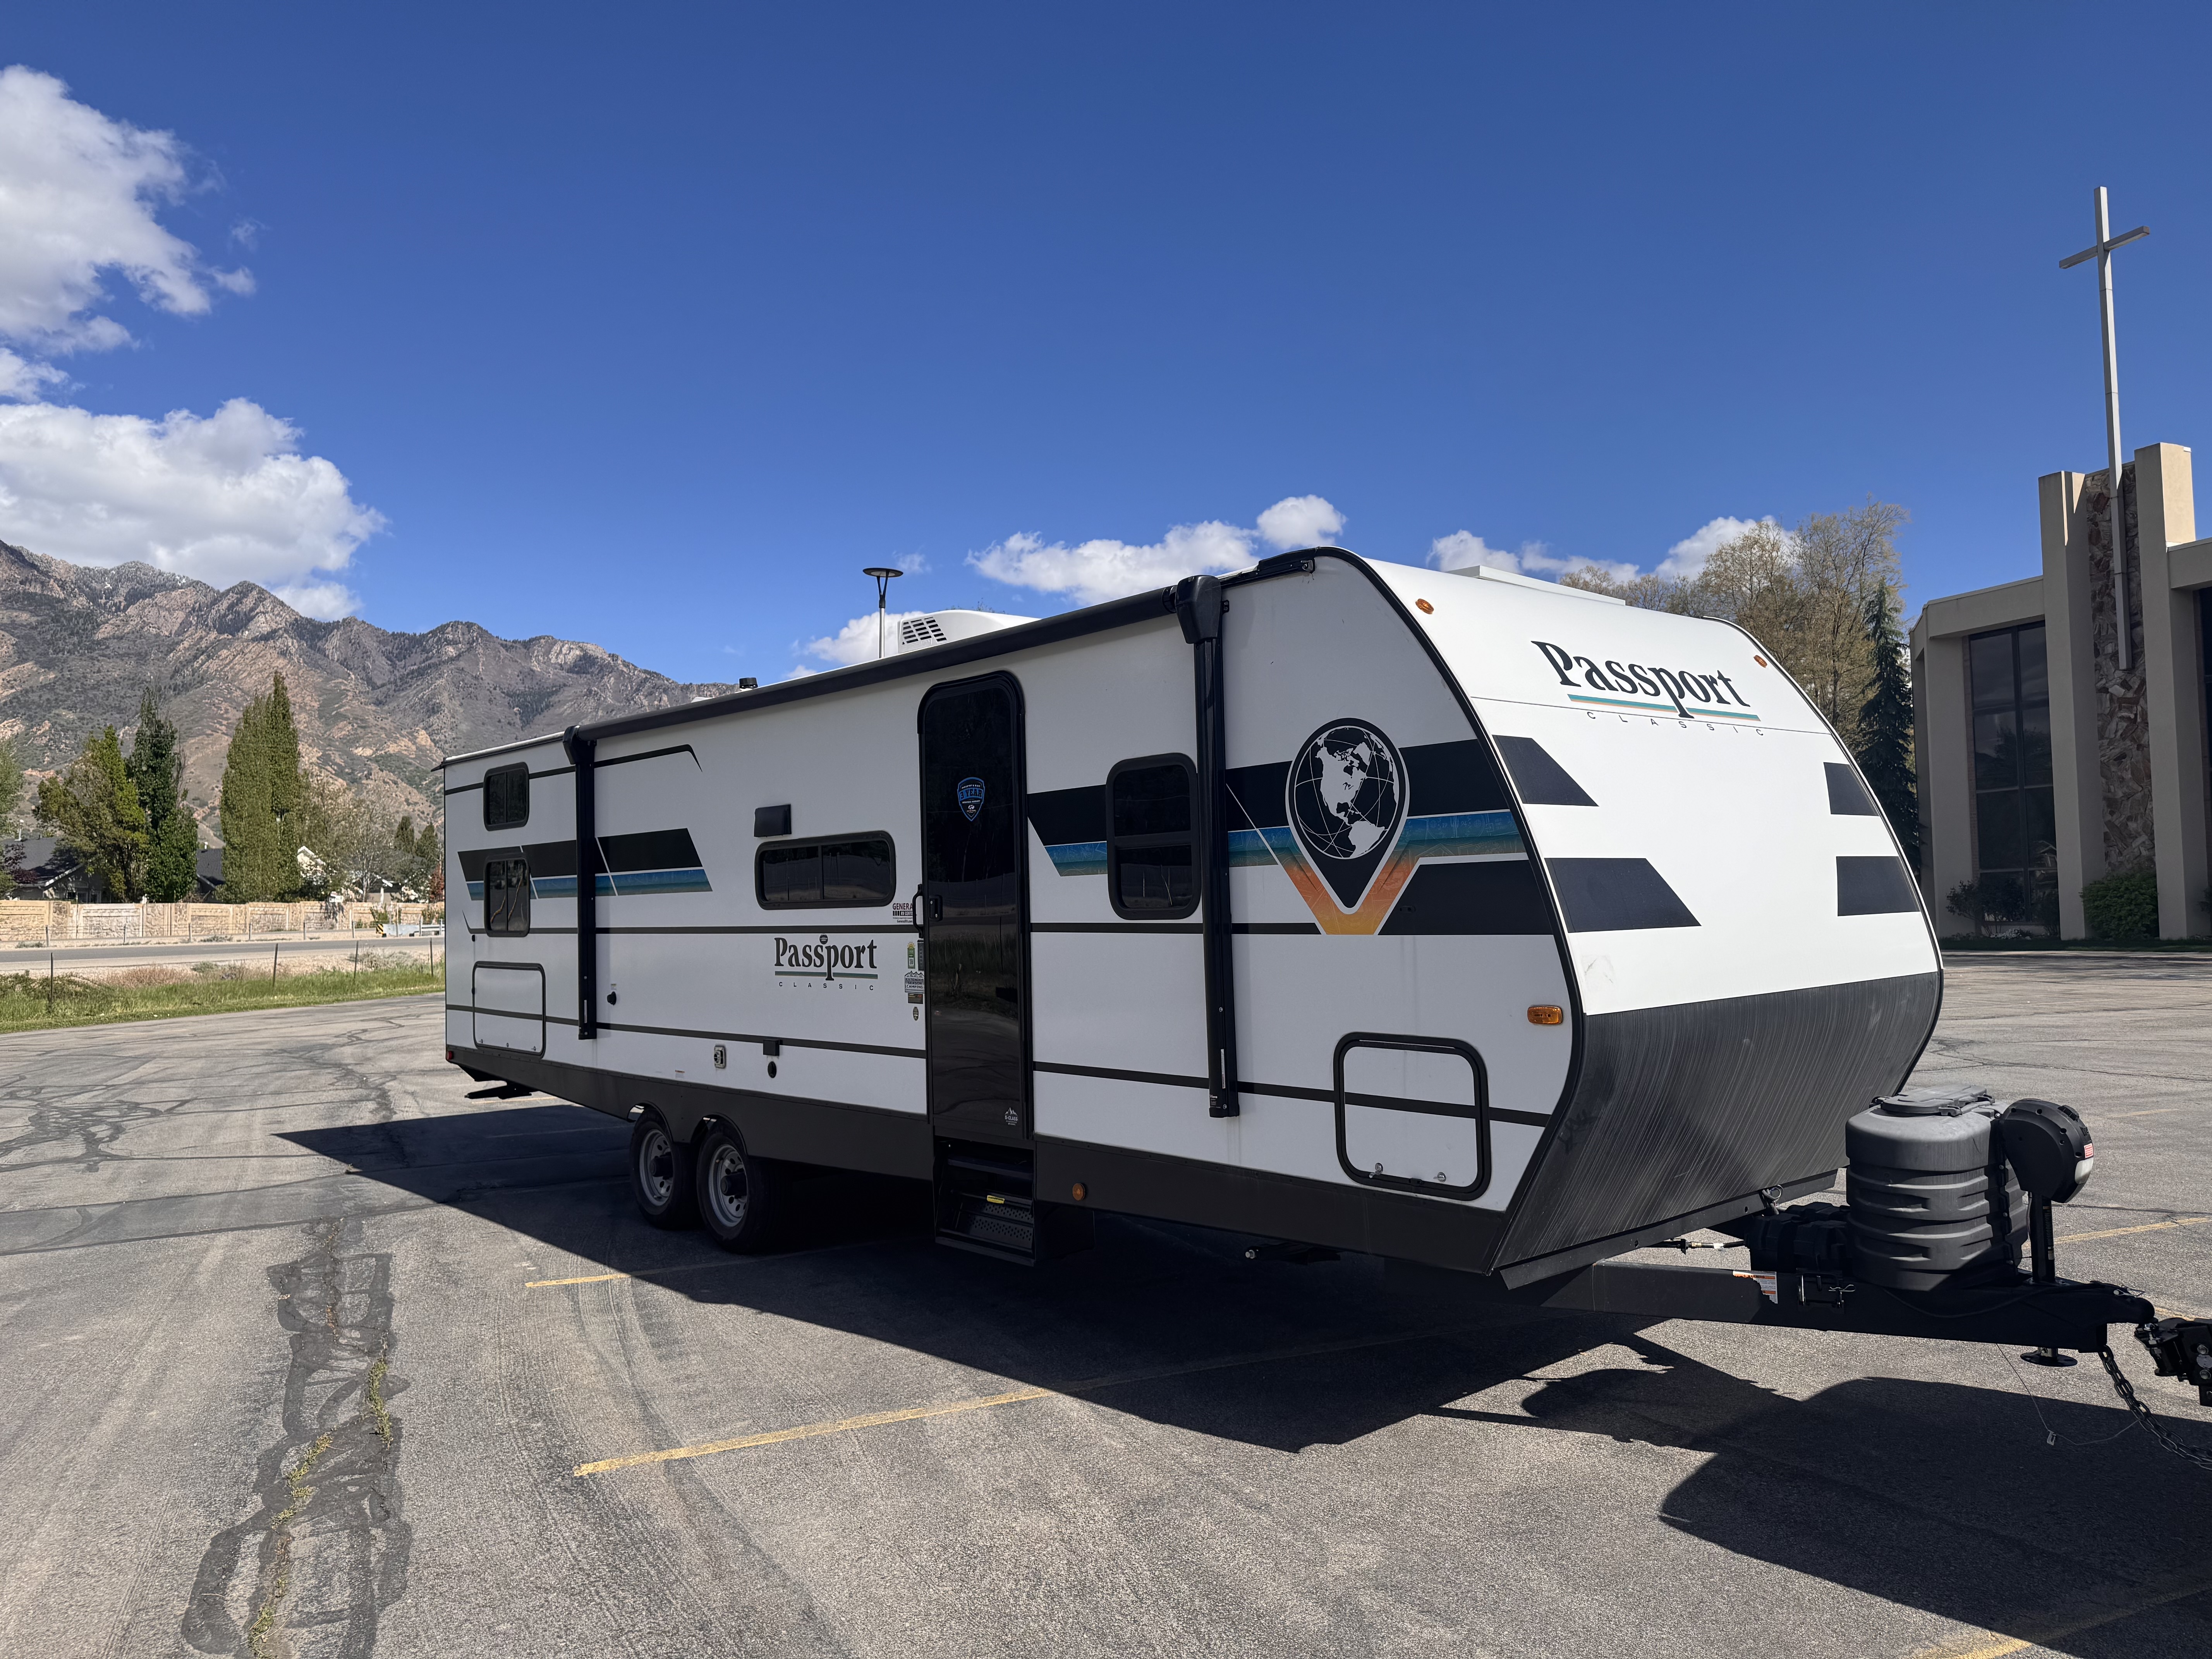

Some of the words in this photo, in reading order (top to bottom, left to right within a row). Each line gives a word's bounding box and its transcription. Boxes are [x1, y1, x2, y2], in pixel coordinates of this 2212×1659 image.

[1531, 641, 1751, 719] Passport
[1587, 711, 1764, 736] CLASSIC
[965, 789, 982, 797] YEAR
[774, 938, 877, 981] Passport
[779, 982, 874, 991] CLASSIC
